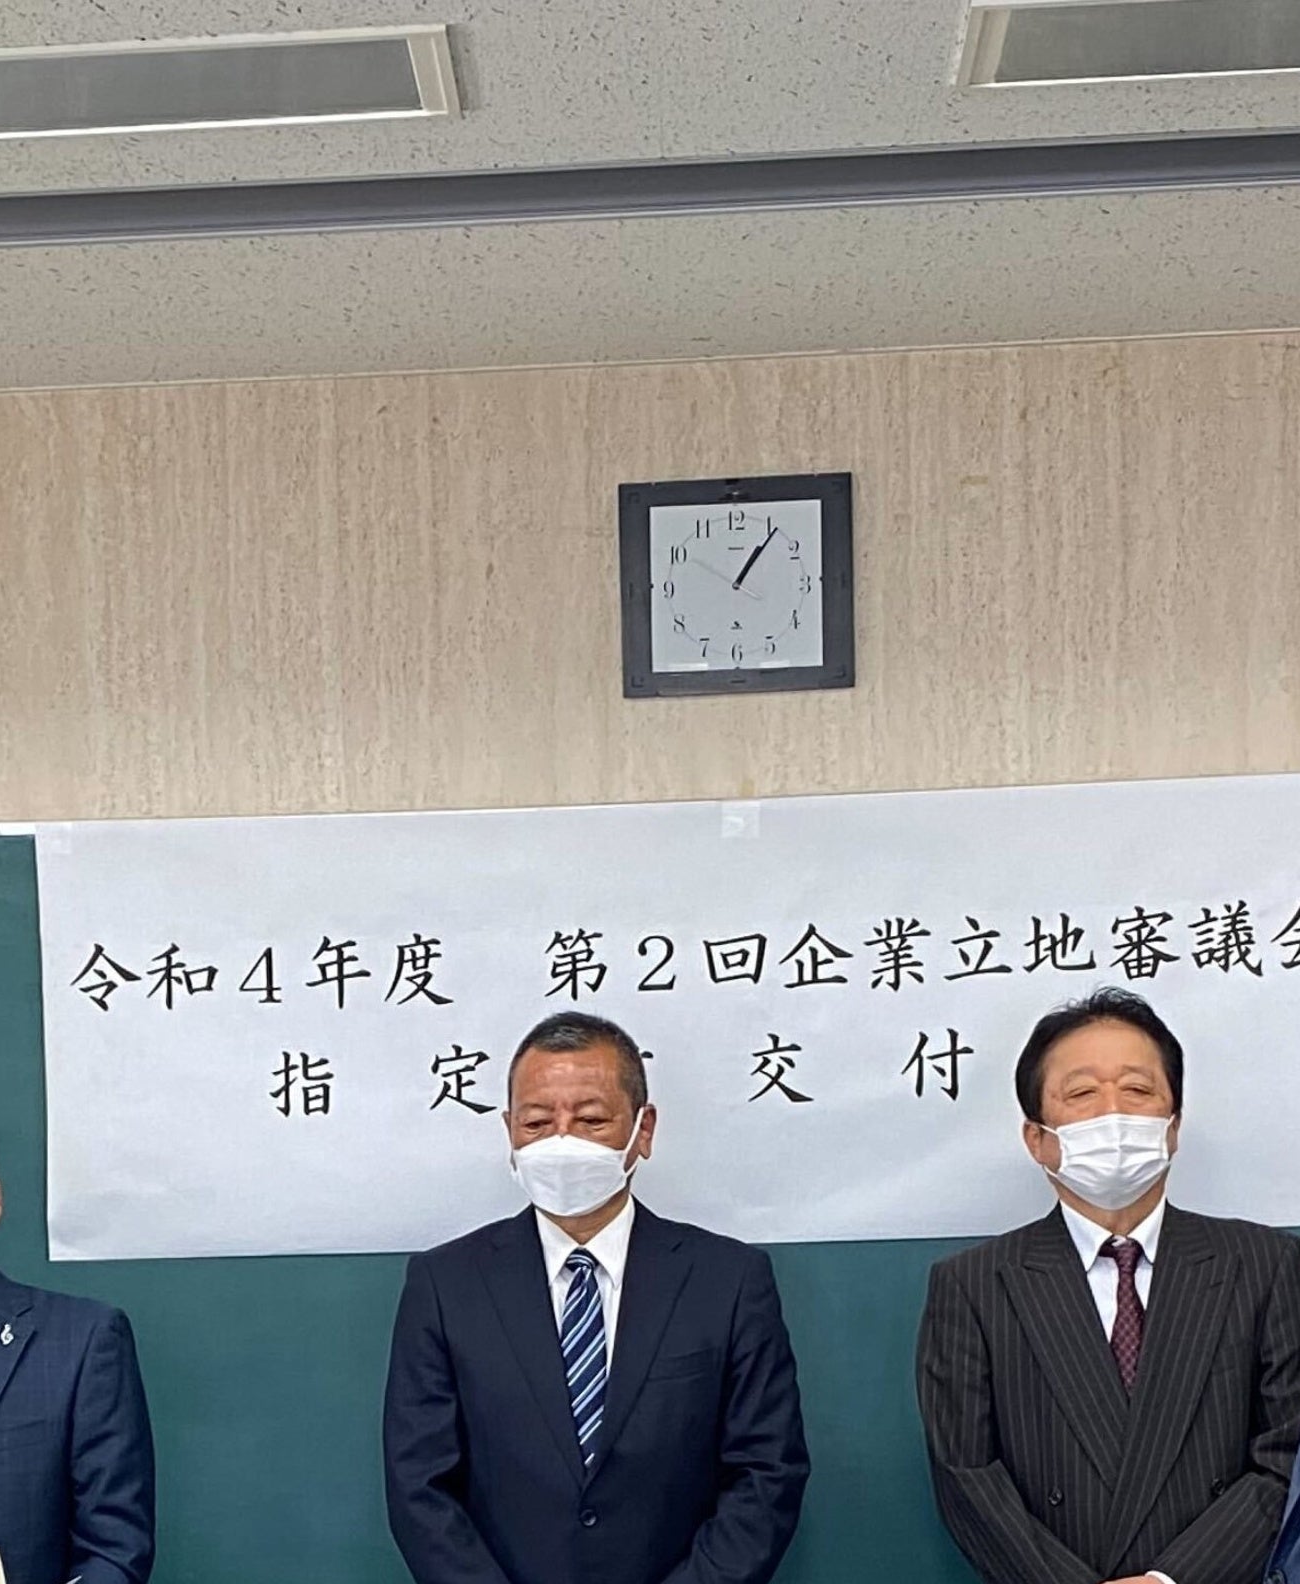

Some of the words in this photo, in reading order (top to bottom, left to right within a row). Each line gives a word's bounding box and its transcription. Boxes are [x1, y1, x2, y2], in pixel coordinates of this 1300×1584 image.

[696, 519, 710, 538] 11
[728, 510, 745, 531] 12
[670, 546, 687, 565] 10
[788, 540, 800, 560] 2
[663, 581, 675, 599] 9
[799, 575, 811, 594] 3
[673, 614, 685, 633] 8
[788, 609, 801, 629] 4
[699, 638, 710, 657] 7
[731, 643, 743, 662] 6
[765, 636, 776, 655] 5
[69, 933, 455, 1012] 令和4年度
